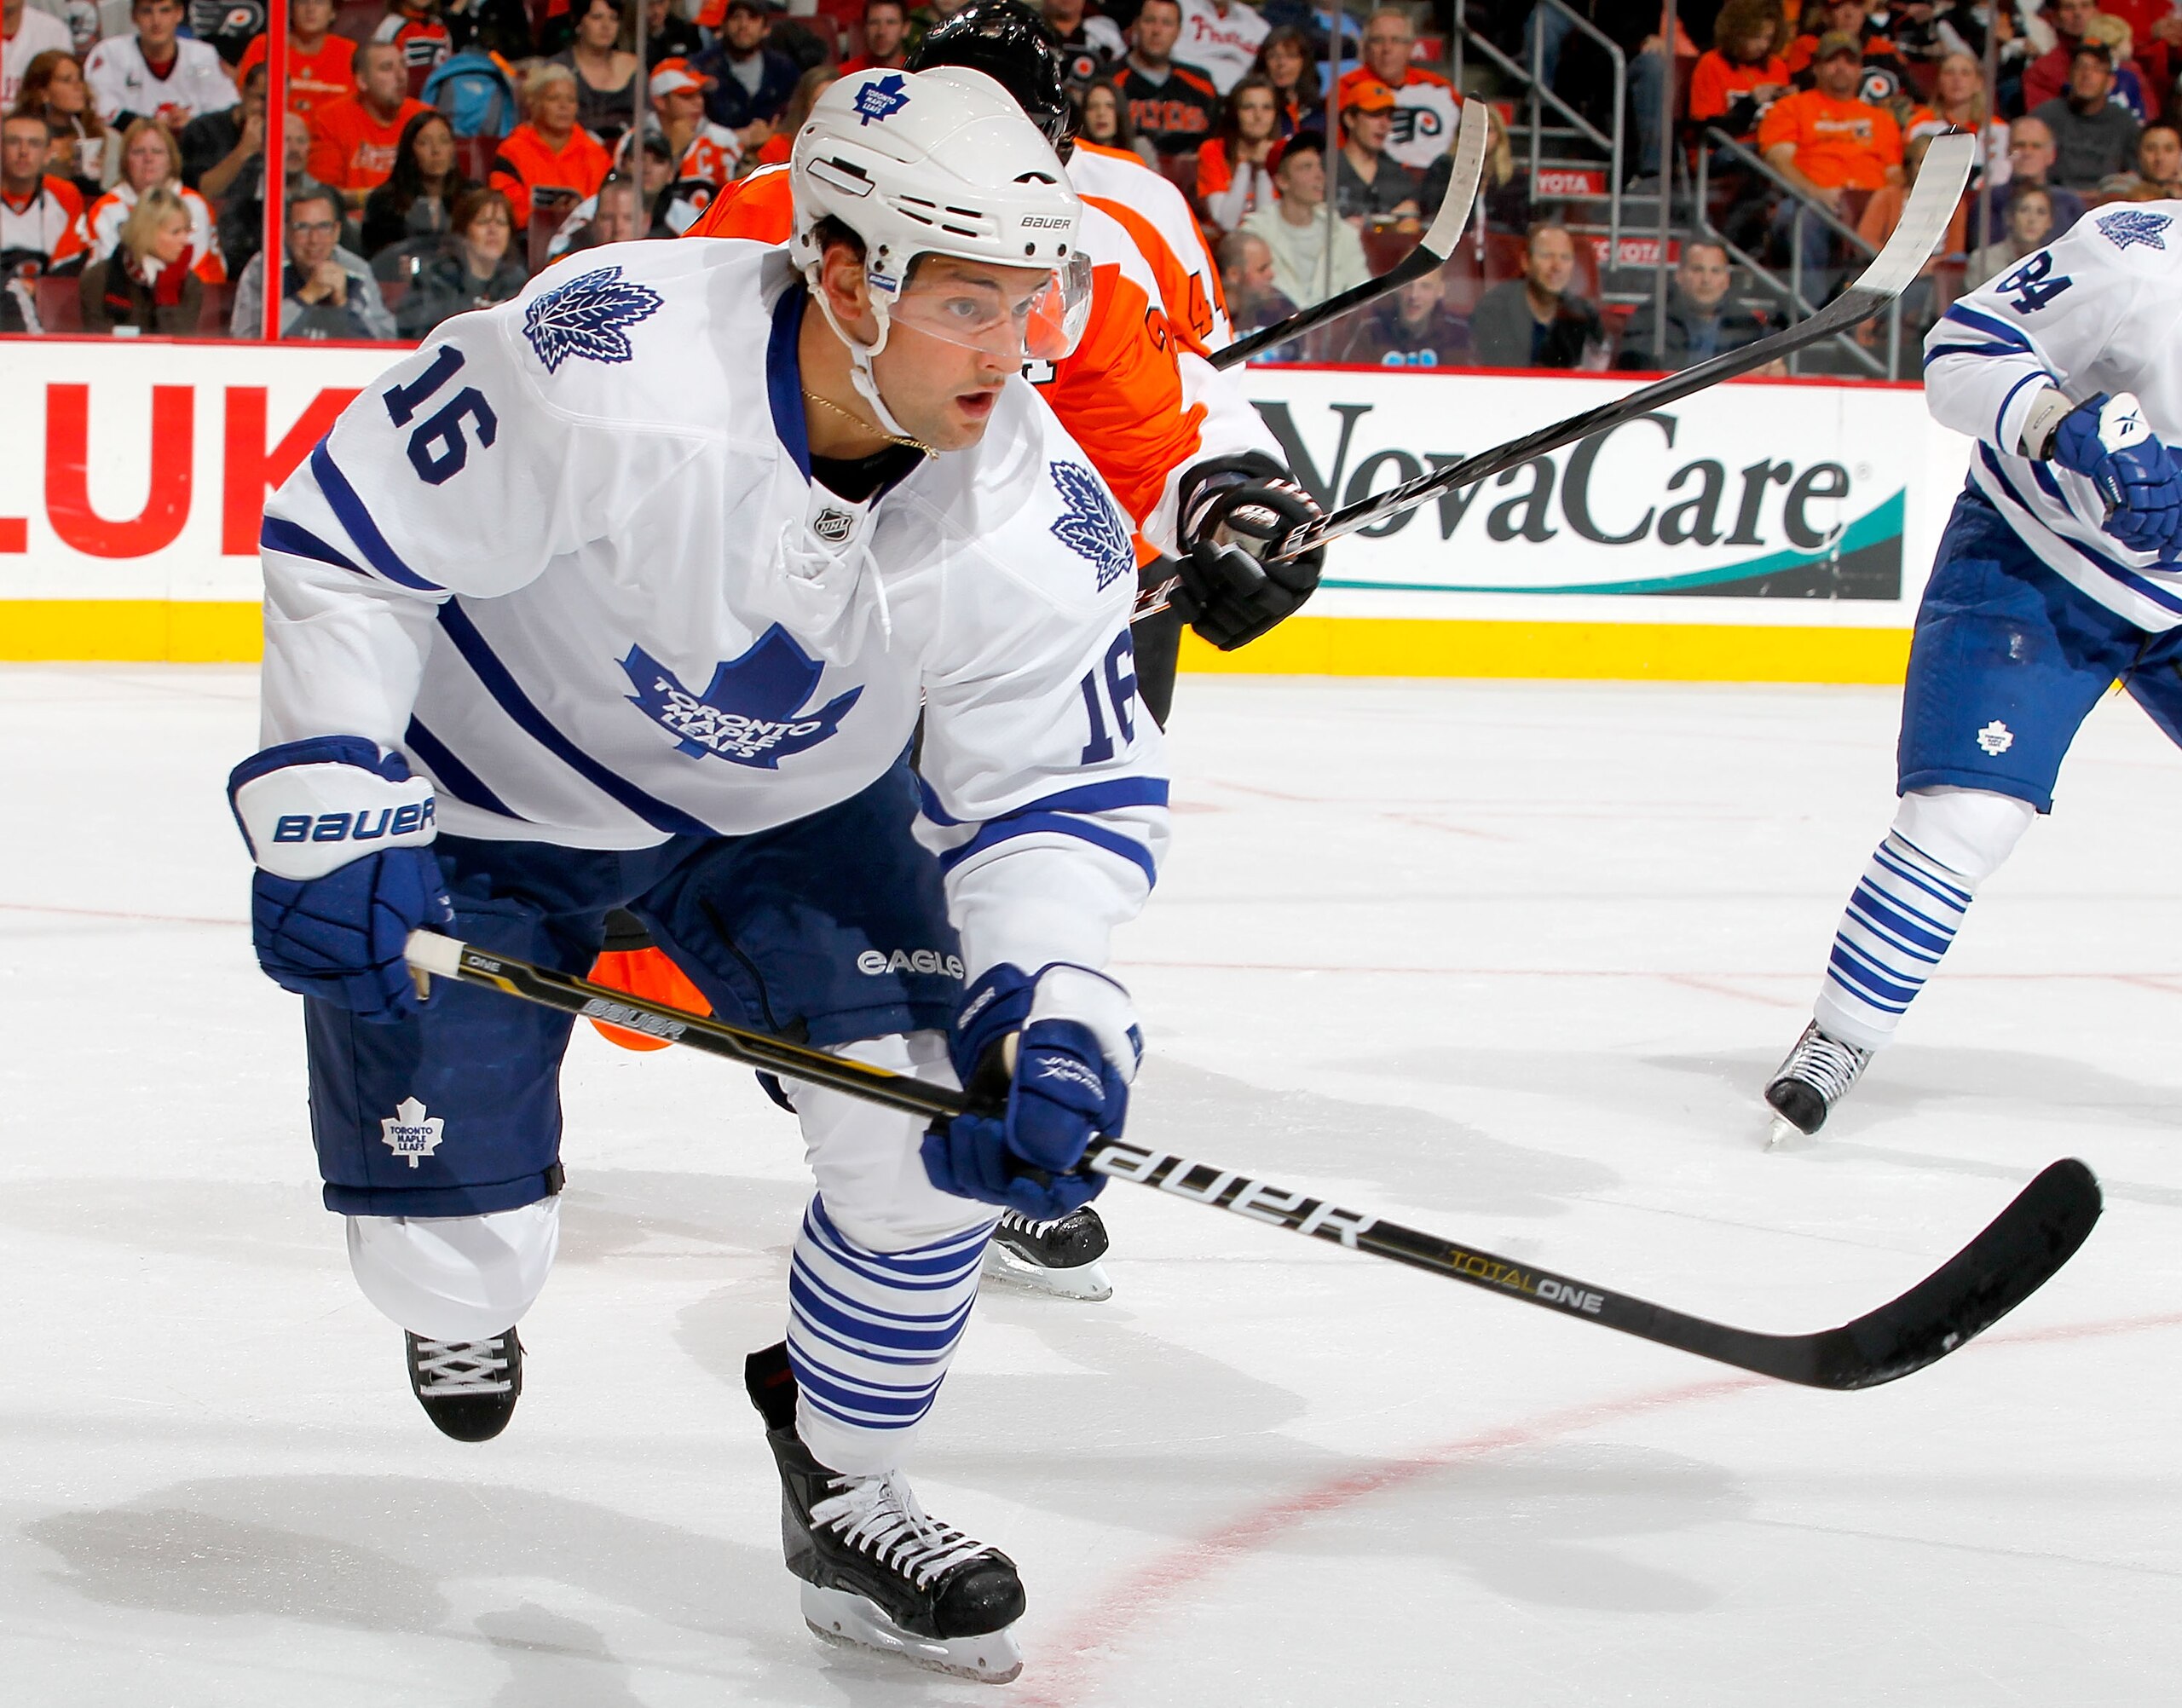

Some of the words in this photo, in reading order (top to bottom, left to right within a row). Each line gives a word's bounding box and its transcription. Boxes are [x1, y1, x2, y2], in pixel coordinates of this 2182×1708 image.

[865, 89, 897, 105] TORONTO
[1021, 216, 1071, 230] BAUER
[1994, 250, 2073, 314] 84
[382, 344, 498, 486] 16
[1250, 401, 1850, 549] NovaCare
[819, 518, 848, 533] NHL
[654, 676, 822, 737] TORONTO
[1081, 627, 1138, 765] 16
[661, 703, 782, 748] MAPLE
[661, 713, 762, 758] LEAFS
[273, 797, 436, 842] BAUER
[468, 955, 501, 973] ONE
[857, 949, 965, 979] EAGLE
[580, 997, 687, 1041] BAUER
[390, 1126, 433, 1134] TORONTO
[397, 1134, 427, 1143] MAPLE
[398, 1143, 424, 1151] LEAFS
[1089, 1145, 1382, 1249] AUER
